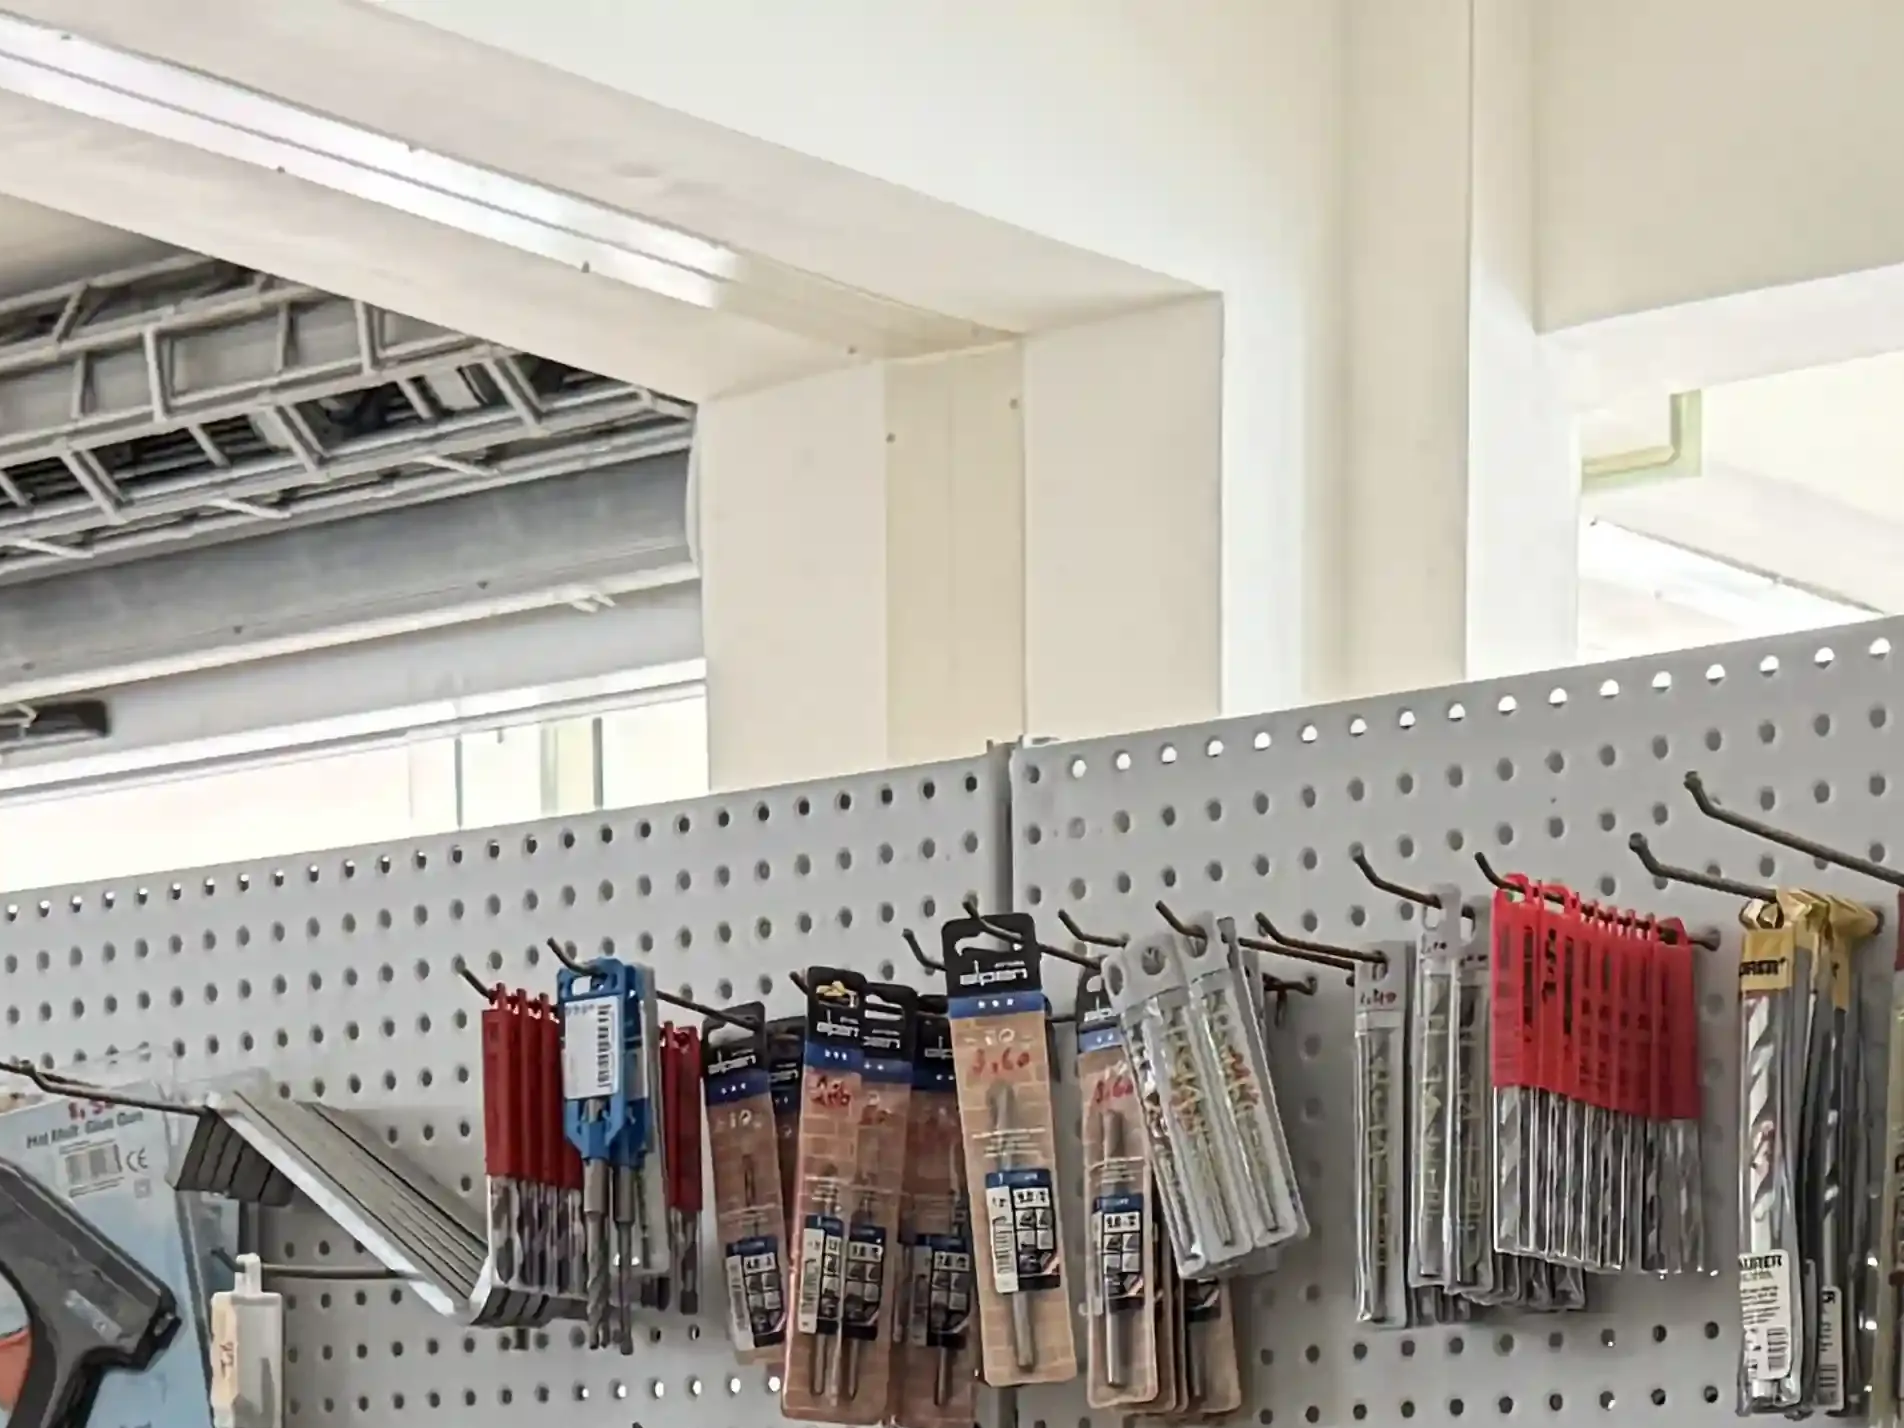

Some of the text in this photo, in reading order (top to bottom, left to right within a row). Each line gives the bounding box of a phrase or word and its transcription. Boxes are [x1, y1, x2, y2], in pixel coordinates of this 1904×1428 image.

[959, 959, 1028, 987] alpen
[817, 1007, 860, 1038] alpen
[707, 1050, 757, 1076] alpen
[125, 1149, 148, 1171] CE
